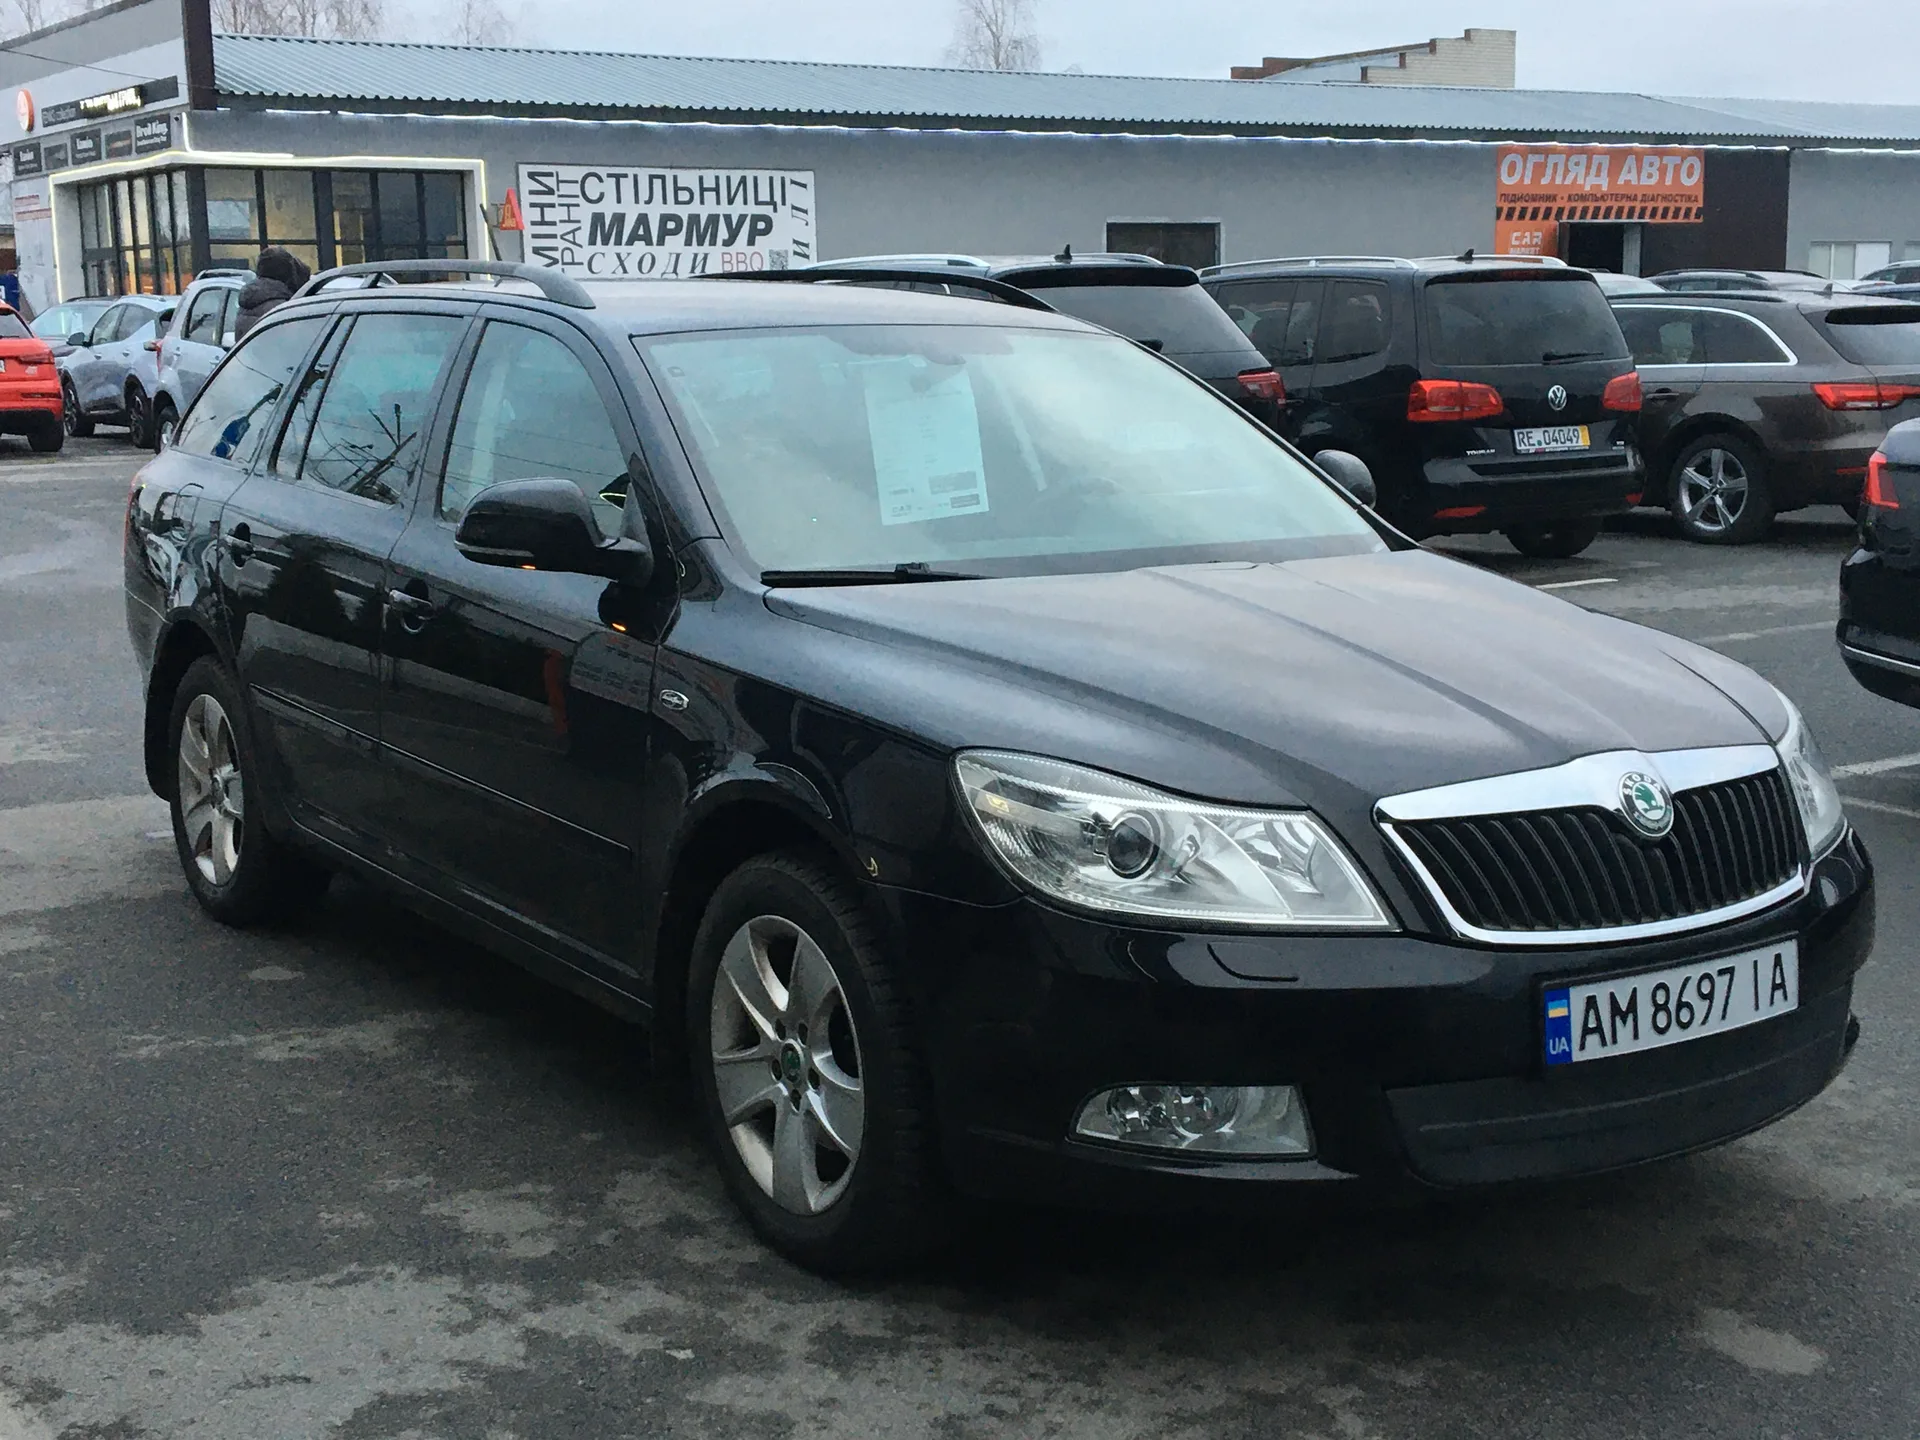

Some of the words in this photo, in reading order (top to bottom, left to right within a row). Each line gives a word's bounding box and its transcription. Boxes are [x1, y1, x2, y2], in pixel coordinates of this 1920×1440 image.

[1500, 154, 1610, 191] ОГЛЯД
[1617, 155, 1701, 187] АВТО
[580, 171, 787, 213] СТІЛЬНИЦІ
[556, 171, 584, 274] РАНІТ
[588, 211, 774, 247] МАРМУР
[1511, 231, 1542, 246] CAR
[587, 251, 711, 279] СХОДИ
[721, 251, 764, 273] BBQ
[1517, 430, 1536, 448] RE
[1542, 428, 1580, 446] 04049
[1579, 986, 1639, 1051] AM
[1651, 965, 1736, 1035] 8697
[1753, 952, 1788, 1012] IA
[1549, 1037, 1569, 1055] UA
